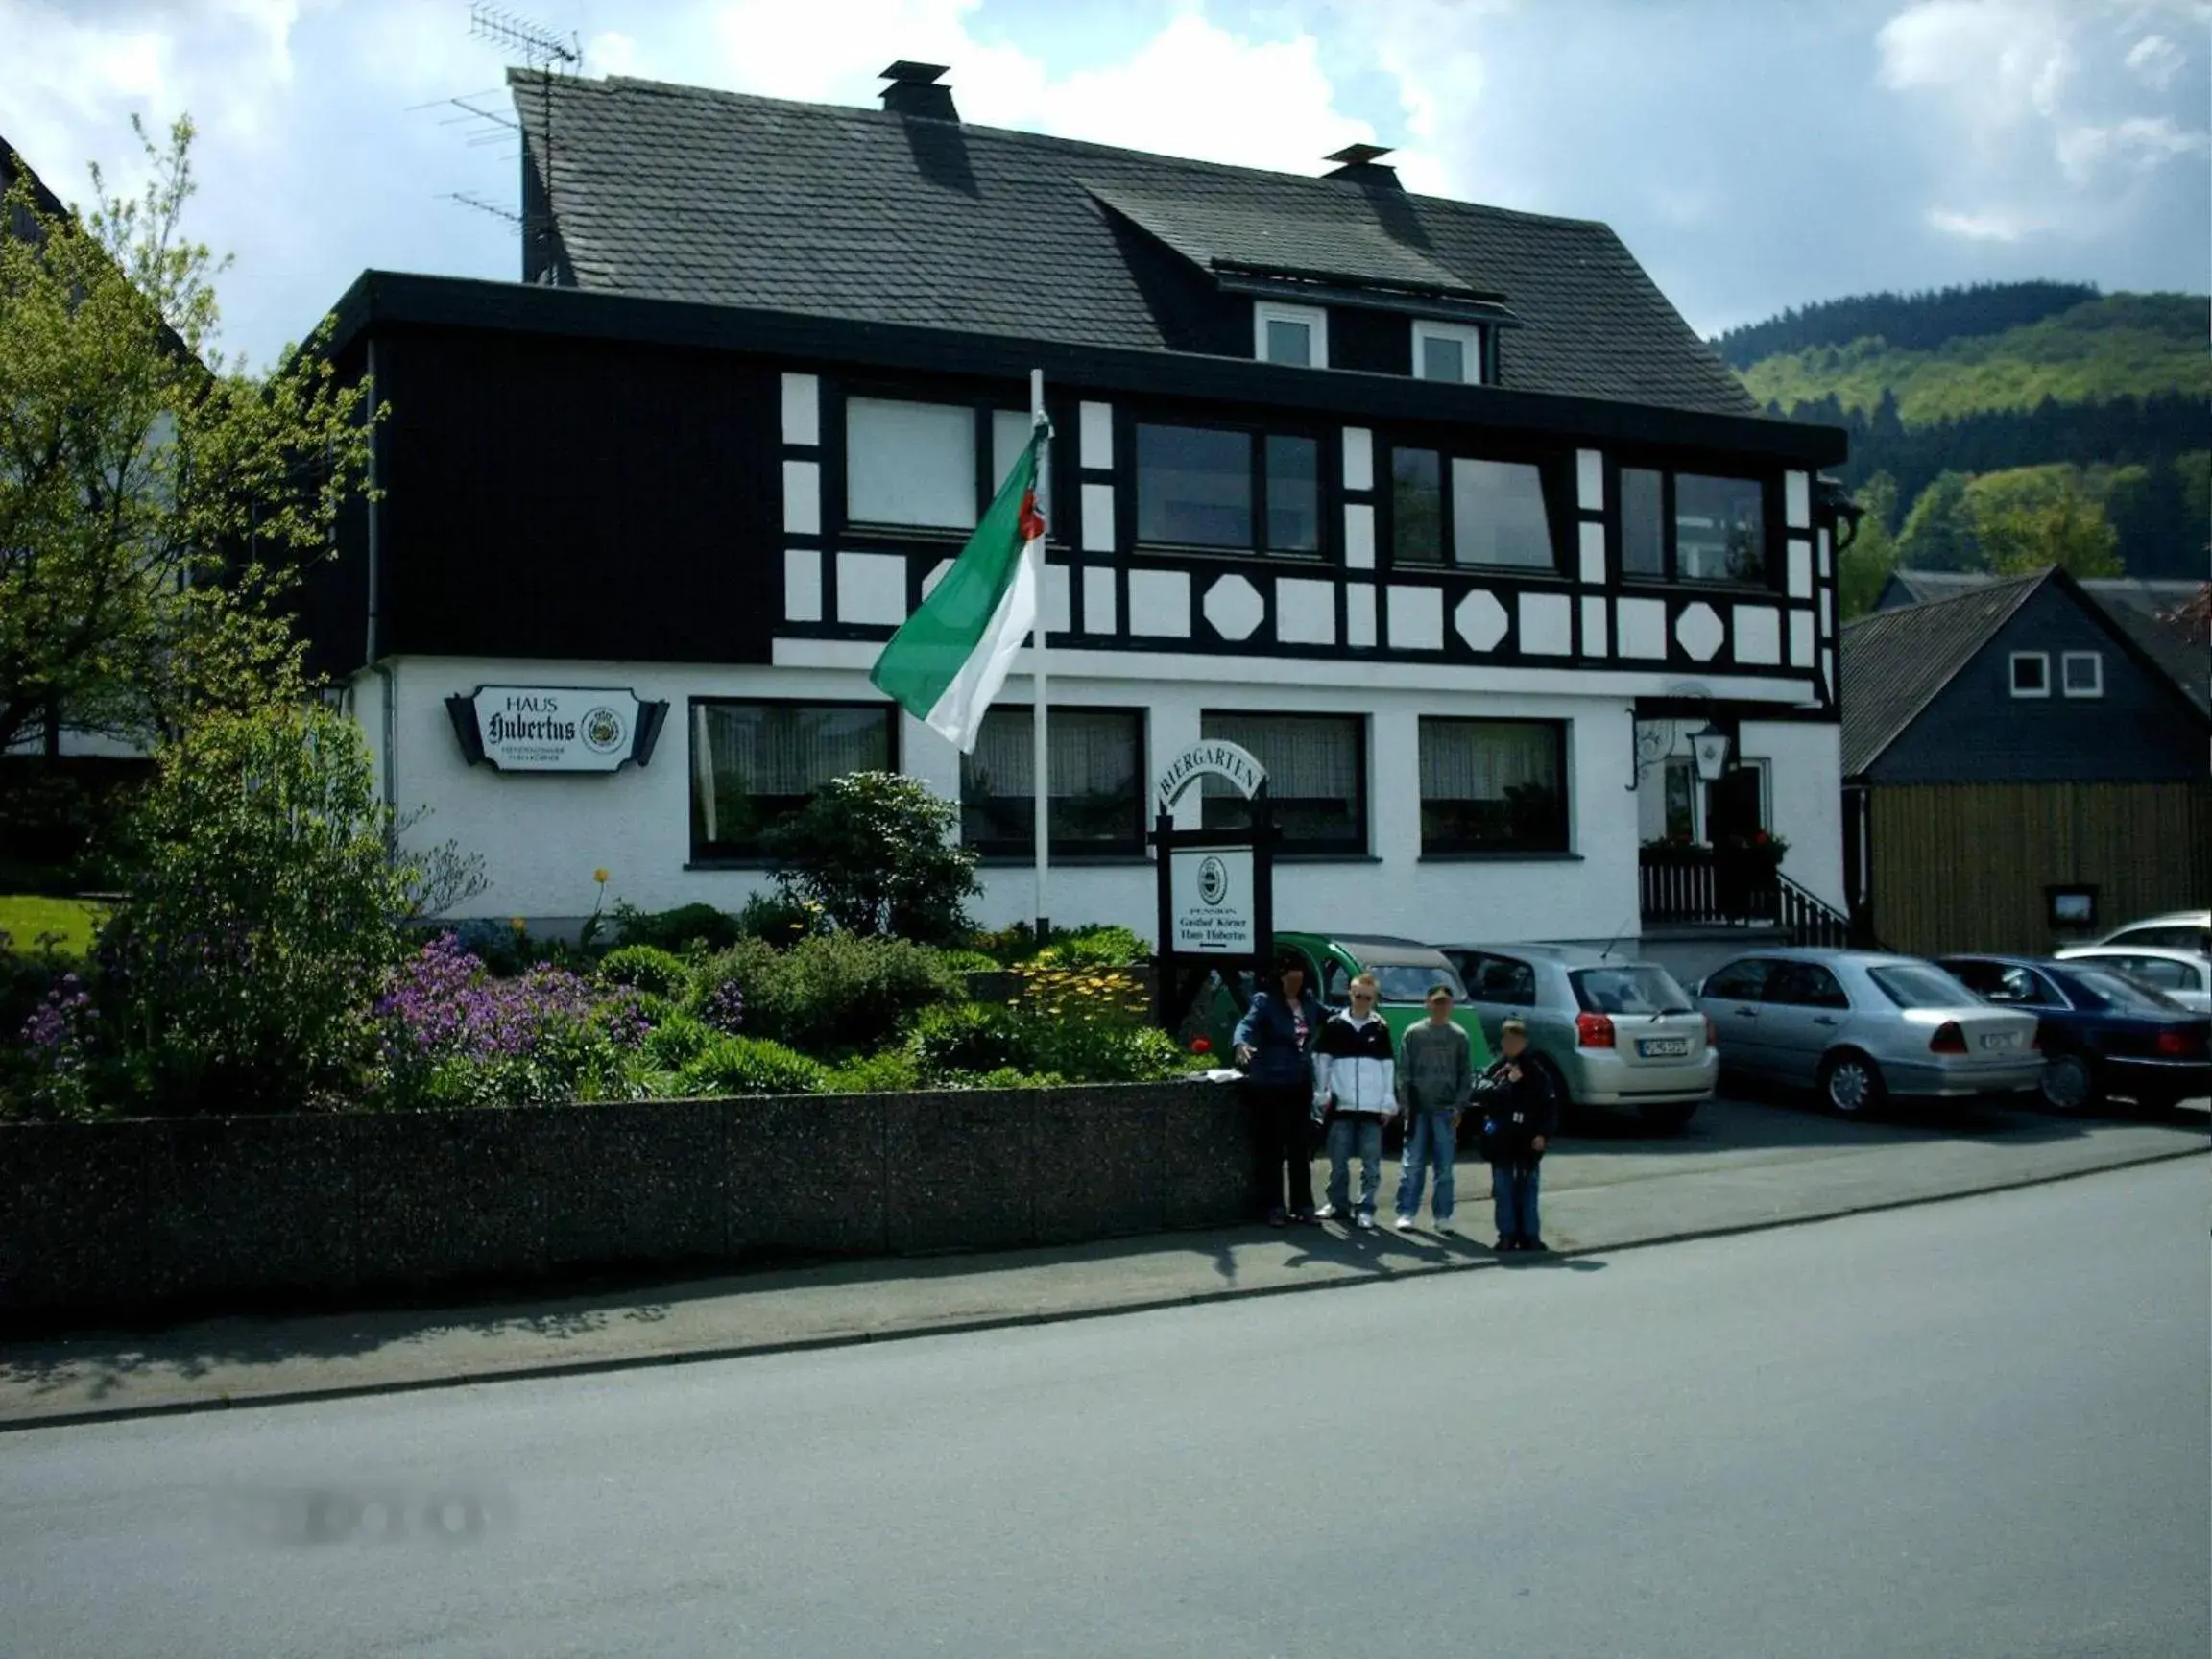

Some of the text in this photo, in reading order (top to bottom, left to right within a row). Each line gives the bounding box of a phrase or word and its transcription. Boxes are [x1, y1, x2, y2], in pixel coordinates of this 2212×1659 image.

[507, 696, 559, 712] HAUS
[489, 712, 576, 744] Hubertus
[1160, 746, 1255, 795] BIERGARTEN
